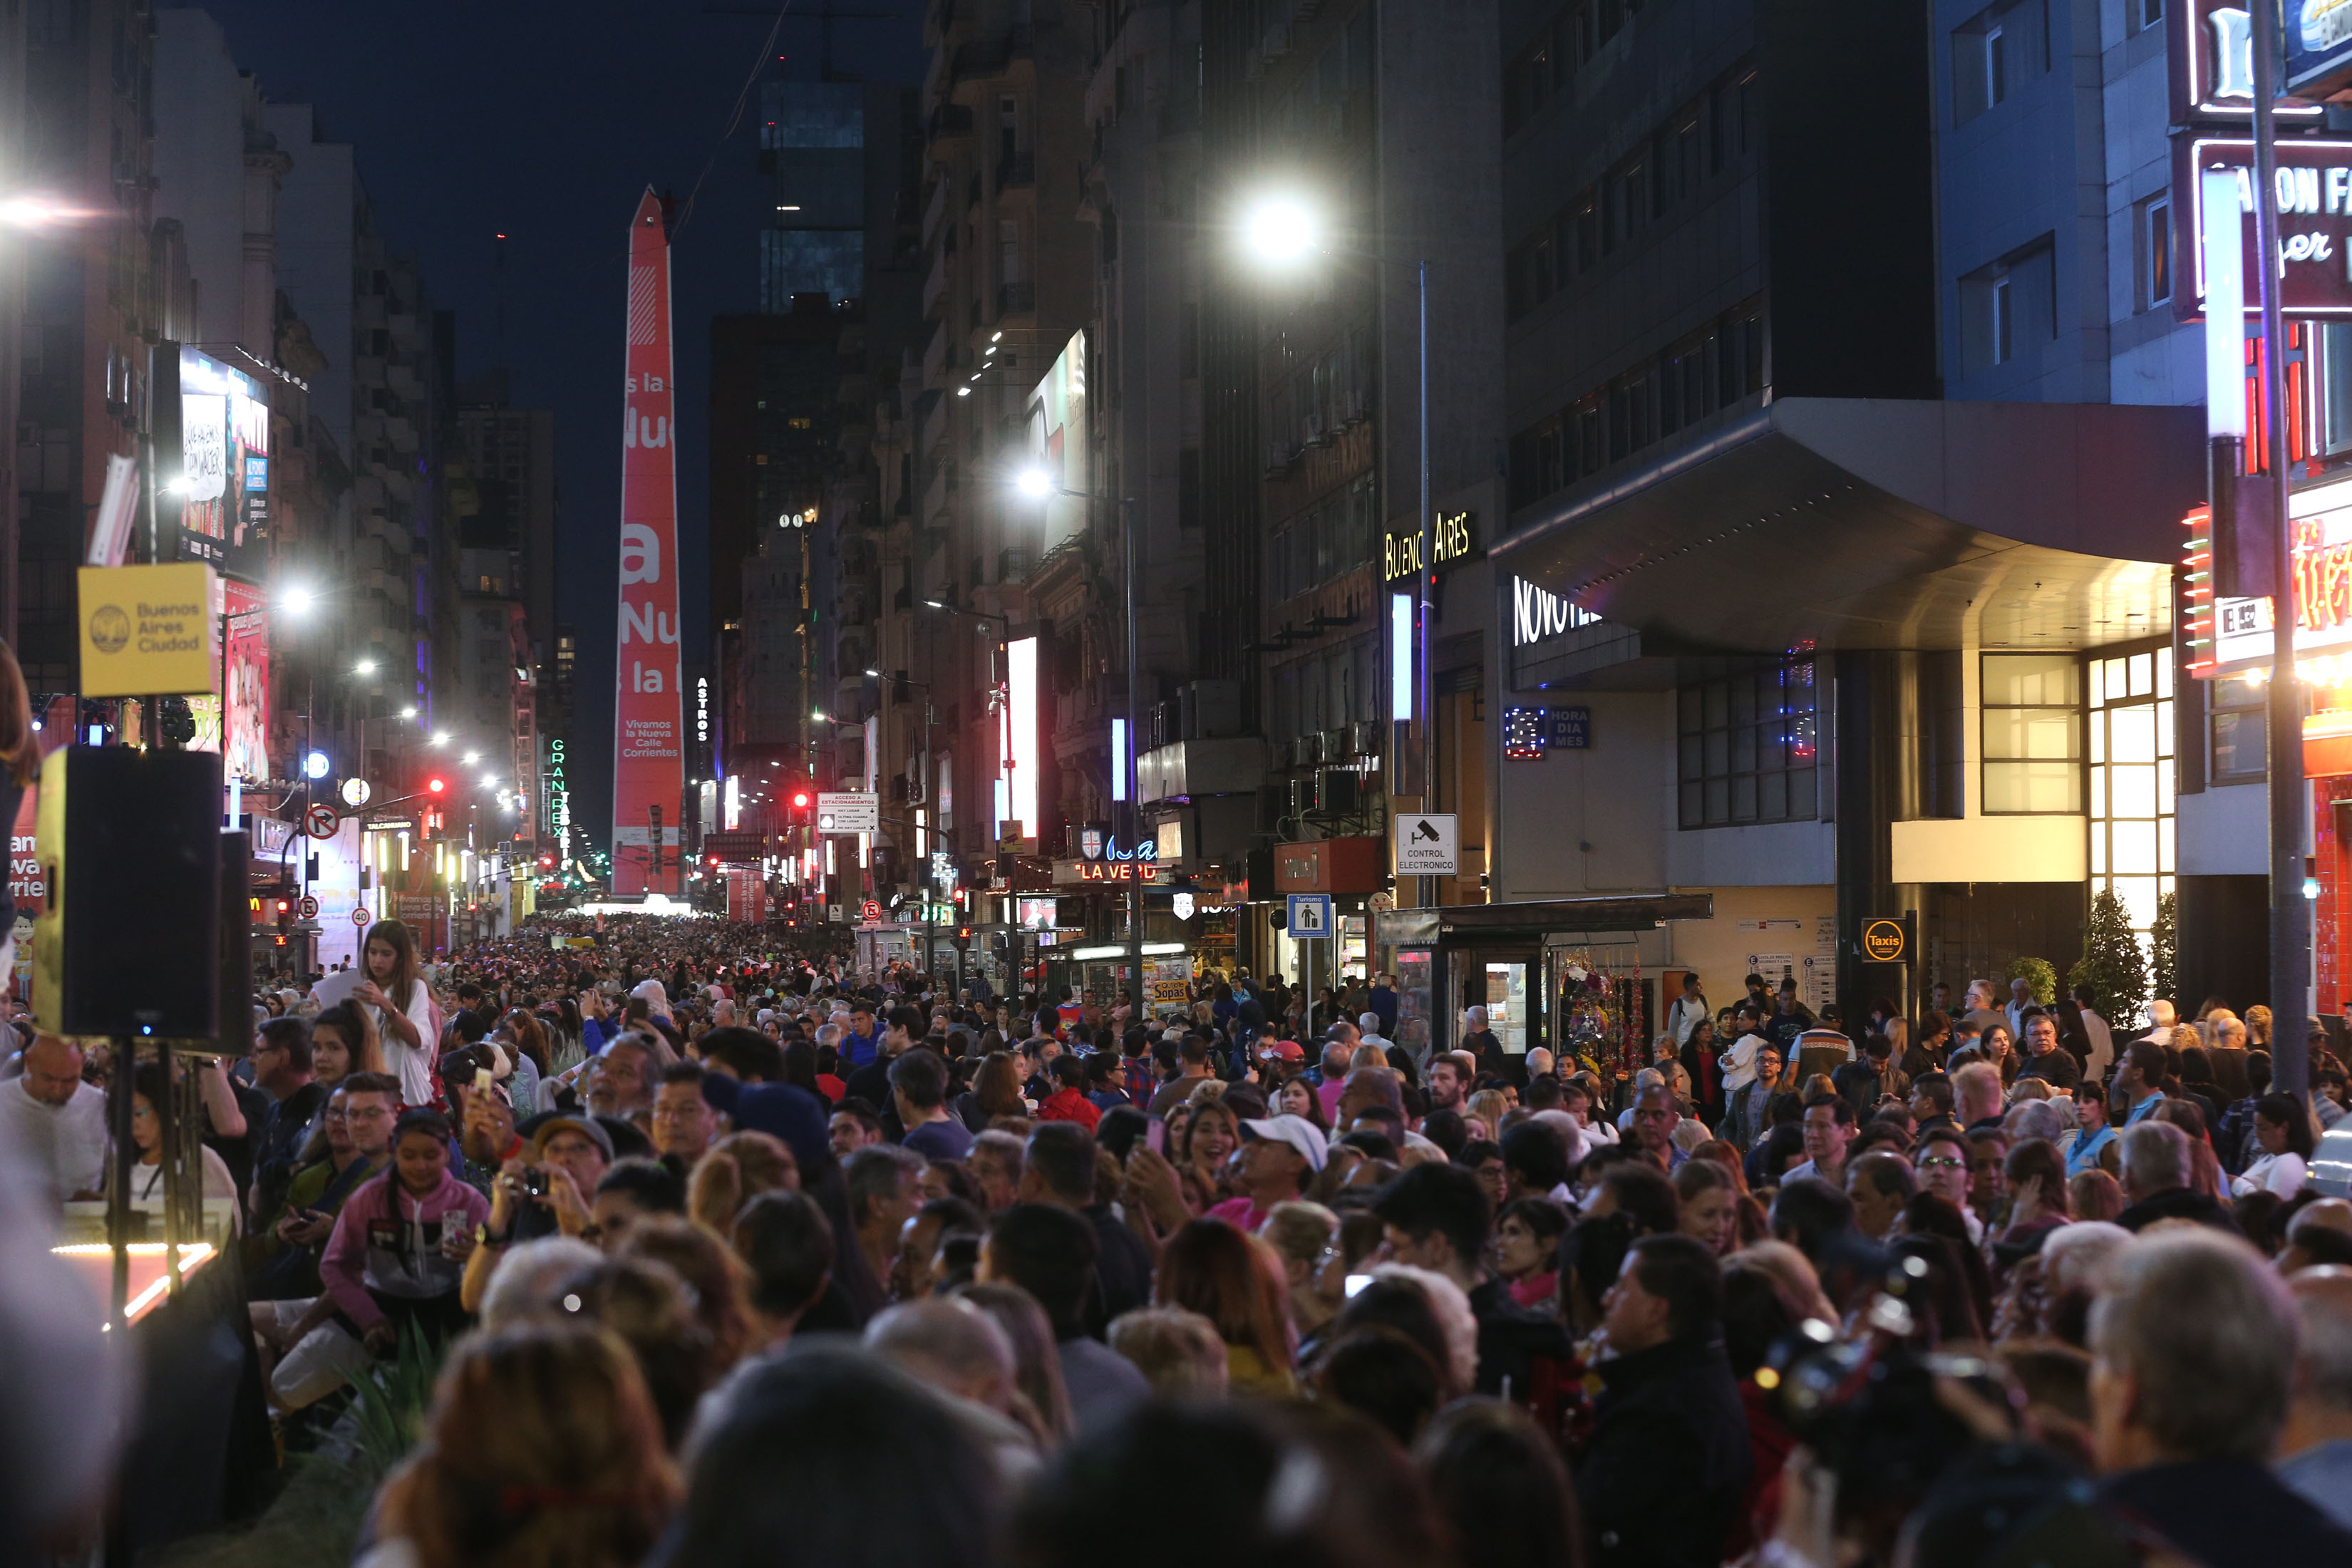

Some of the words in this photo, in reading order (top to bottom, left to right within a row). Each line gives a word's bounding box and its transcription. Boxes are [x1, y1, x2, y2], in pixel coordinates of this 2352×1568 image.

[644, 372, 663, 392] la
[1386, 530, 1424, 582] BUENO
[1433, 512, 1469, 564] AIRES
[138, 603, 199, 617] Buenos
[138, 621, 183, 635] Aires
[138, 636, 200, 652] Ciudad
[634, 661, 663, 693] la
[697, 677, 708, 742] ASTROS
[1551, 711, 1587, 721] HORA
[626, 719, 672, 728] Vivamos
[1557, 723, 1581, 733] DIA
[626, 729, 635, 738] la
[639, 729, 672, 738] Nueva
[636, 738, 662, 747] Calle
[1555, 736, 1584, 746] MES
[623, 748, 679, 757] Corrientes
[552, 739, 565, 792] GRAN
[552, 798, 564, 837] REX
[355, 912, 366, 922] 40
[1869, 935, 1899, 946] Taxis
[1155, 984, 1185, 1000] Sopas
